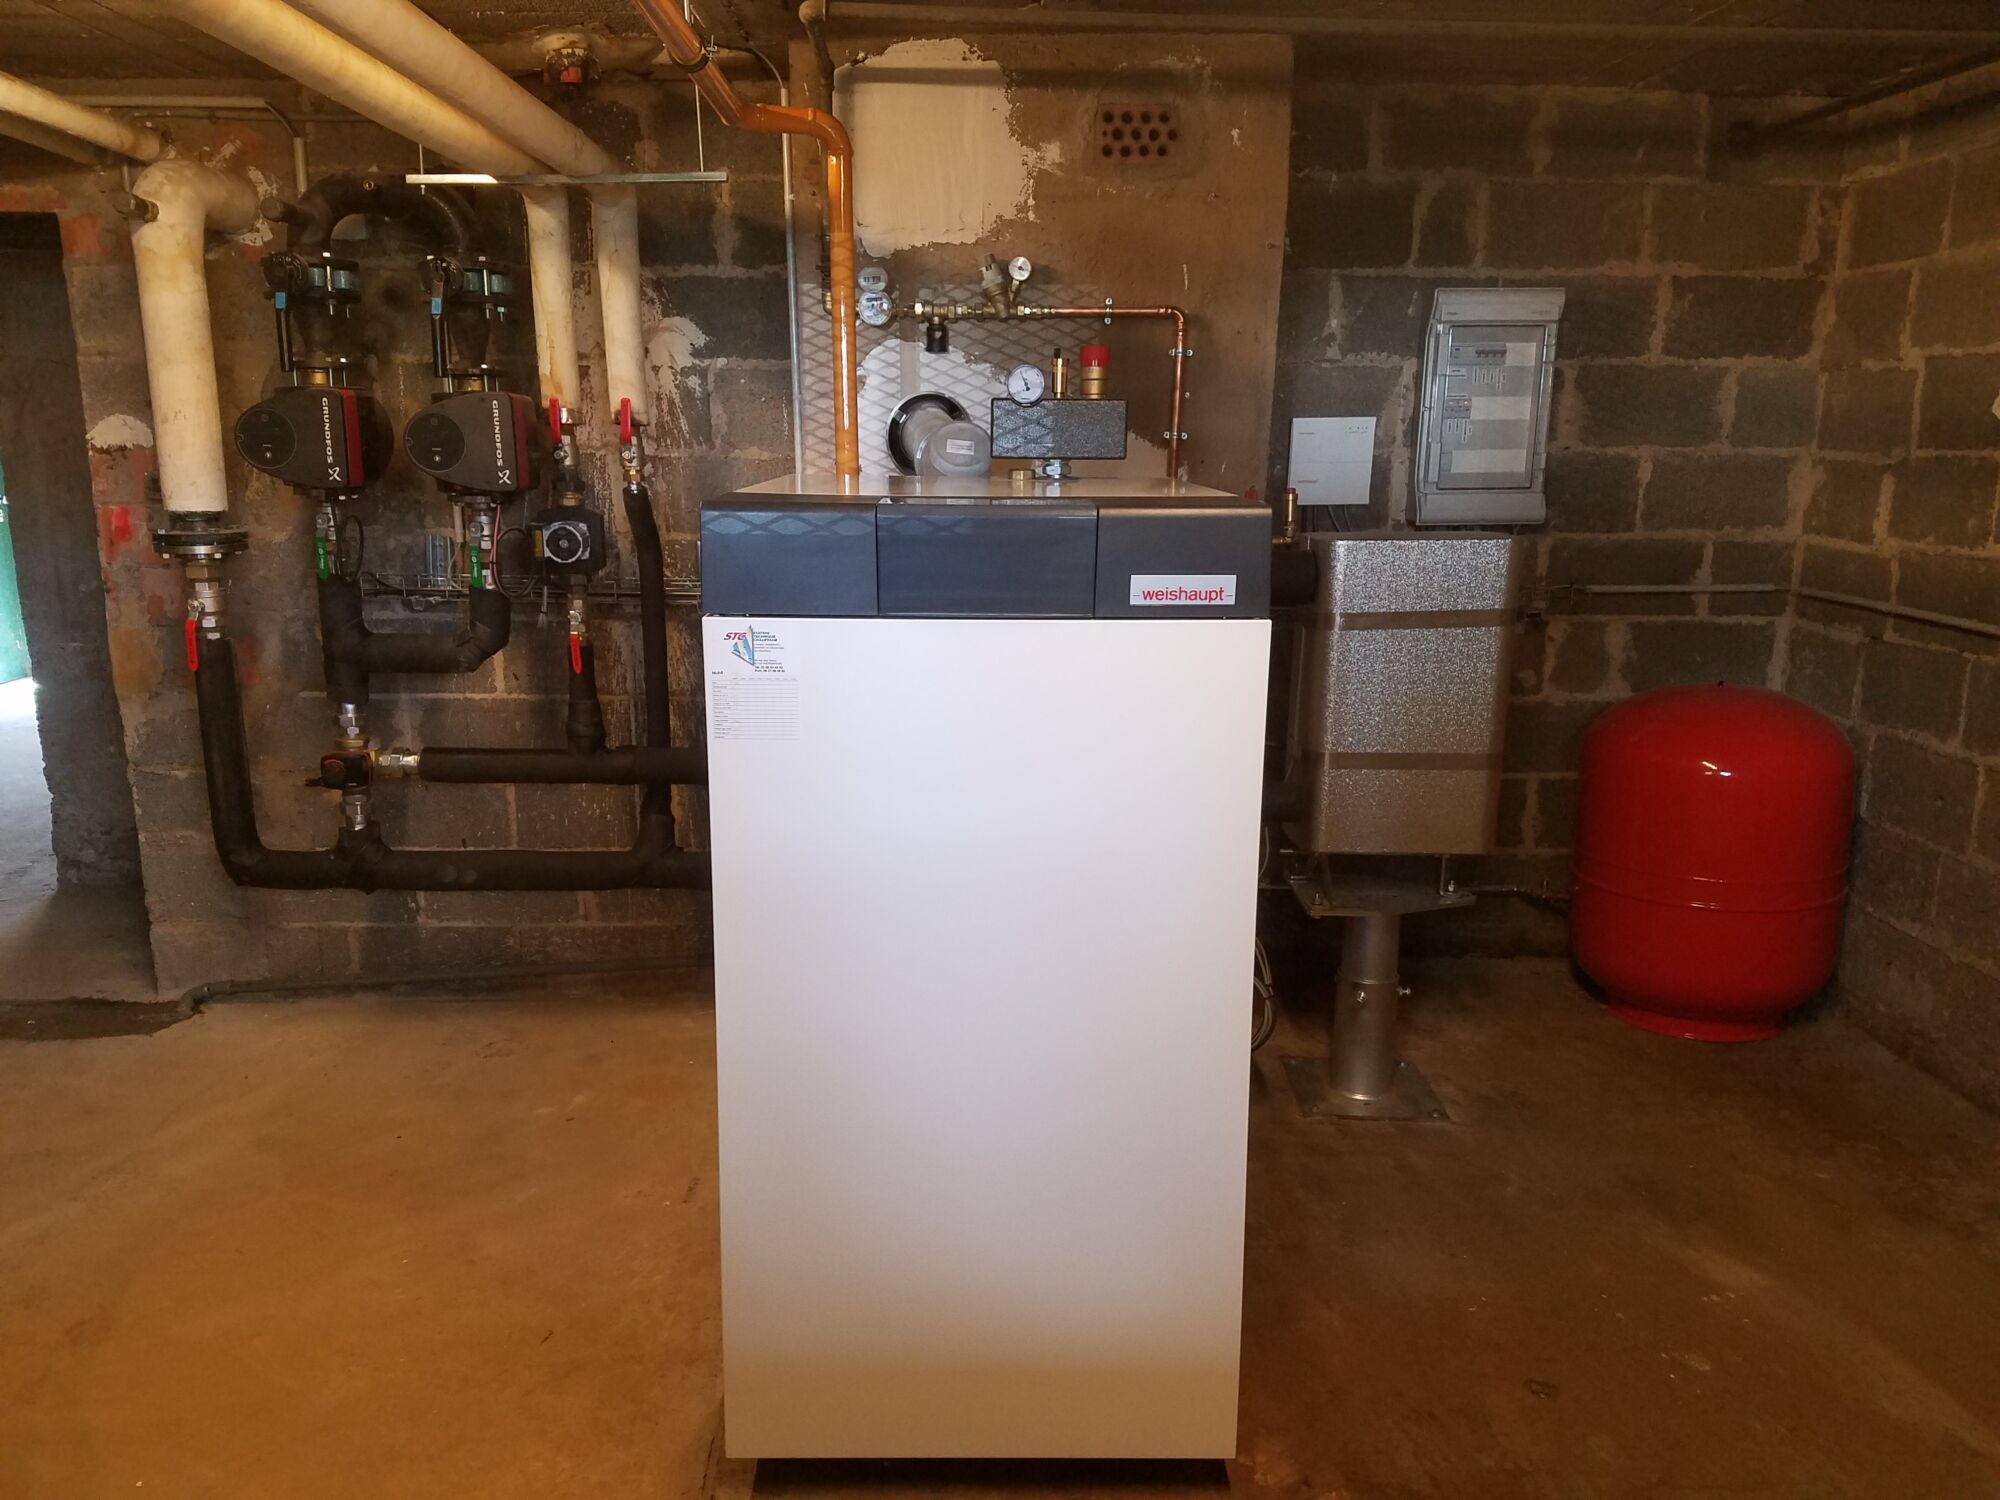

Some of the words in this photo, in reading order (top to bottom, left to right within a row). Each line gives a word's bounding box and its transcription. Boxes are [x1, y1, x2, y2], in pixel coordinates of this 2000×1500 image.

[321, 397, 334, 464] GRUNDFOS
[491, 399, 504, 467] GRUNDFOS
[1142, 586, 1225, 603] weishaupt
